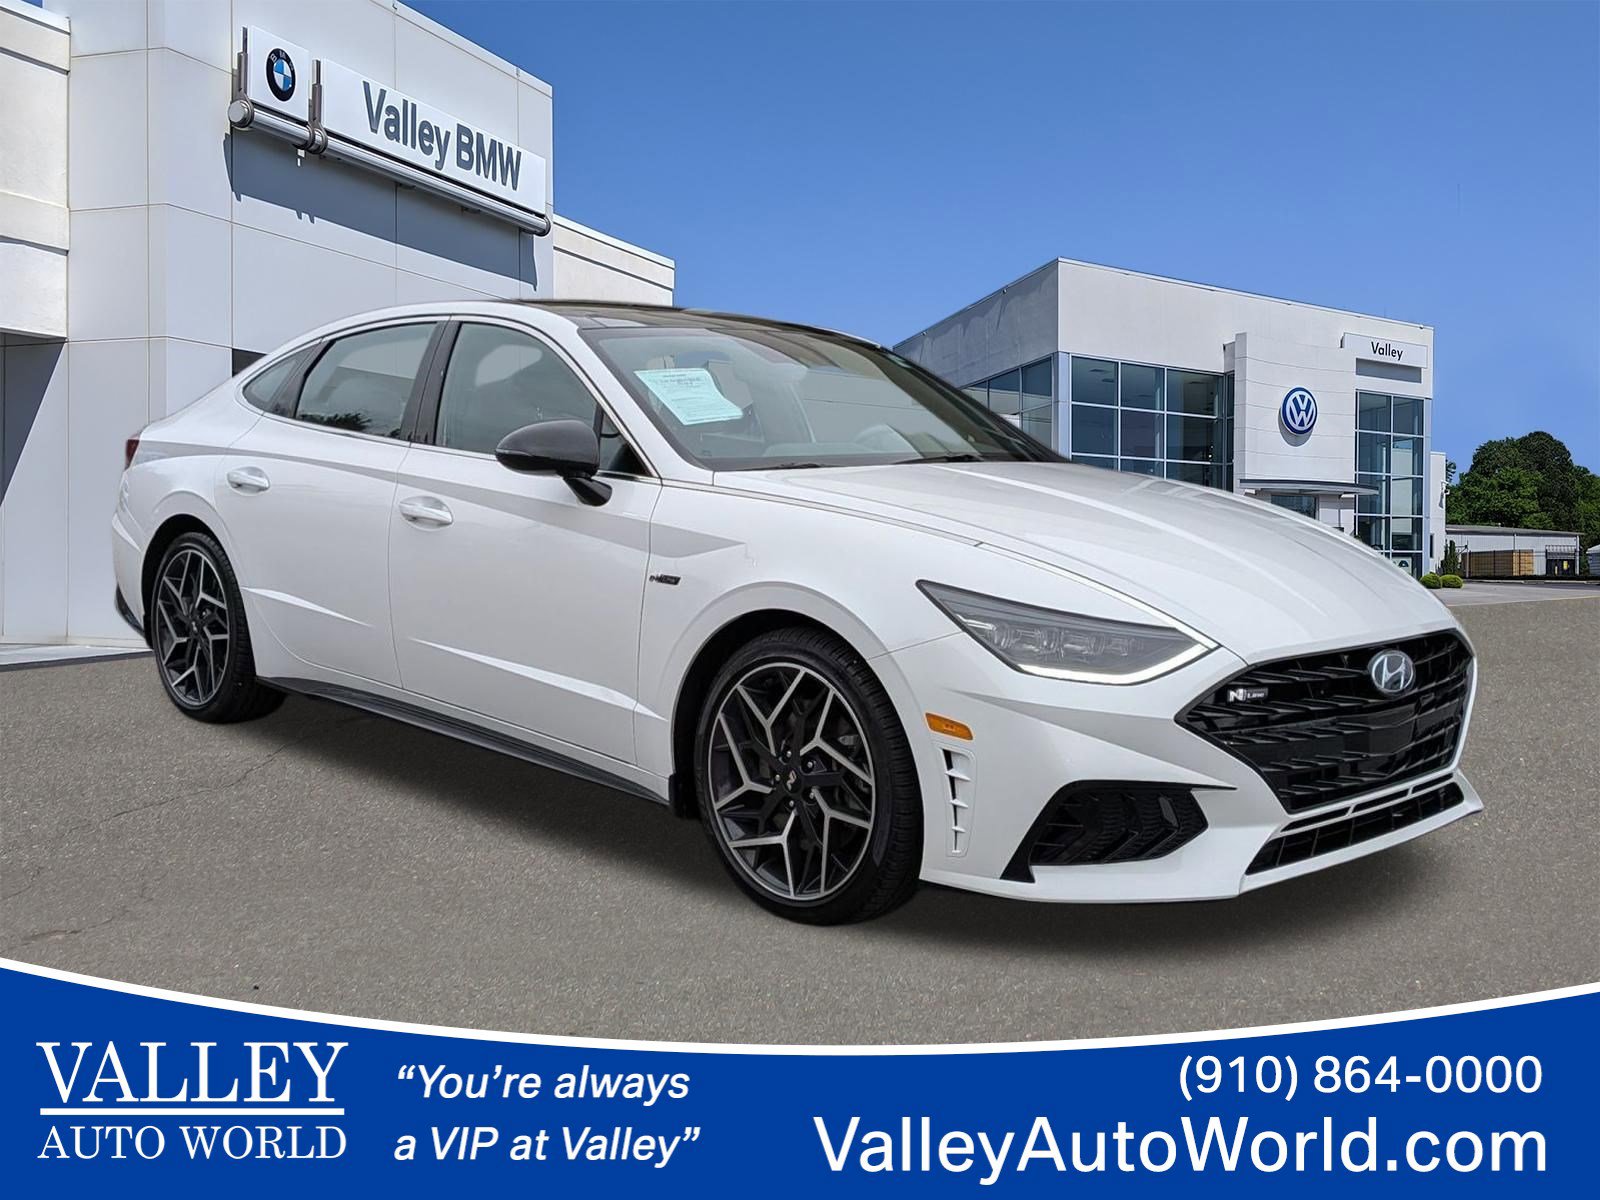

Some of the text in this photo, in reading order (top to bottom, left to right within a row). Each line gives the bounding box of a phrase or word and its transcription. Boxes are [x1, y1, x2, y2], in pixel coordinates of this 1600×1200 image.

[363, 80, 522, 191] Valley BMW
[1371, 341, 1403, 361] Valley
